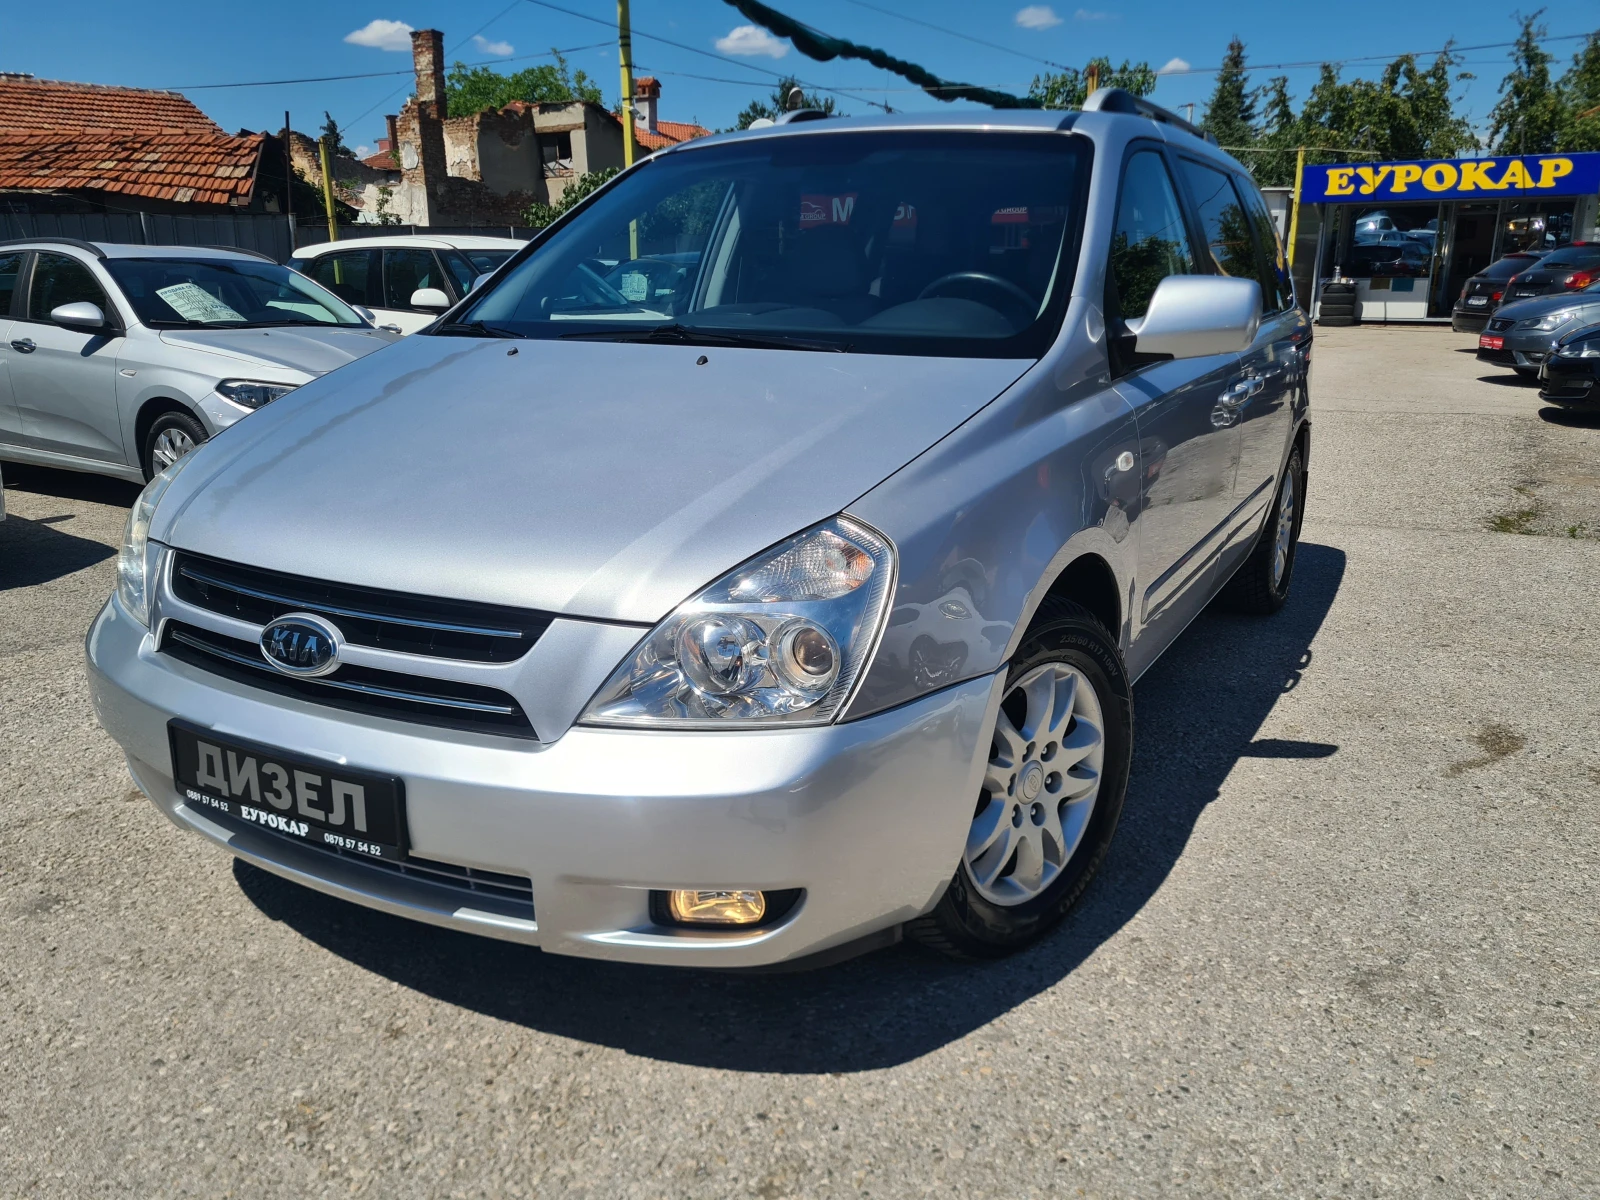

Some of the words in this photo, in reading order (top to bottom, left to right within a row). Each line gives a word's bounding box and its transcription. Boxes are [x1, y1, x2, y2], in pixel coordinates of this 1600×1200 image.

[1324, 158, 1574, 196] ЕУРОКАР
[270, 627, 320, 665] KIA
[1060, 634, 1088, 646] 235/60
[1088, 641, 1104, 655] R17
[1102, 654, 1118, 676] 106V
[196, 740, 367, 832] ДИЗЕЛ
[202, 795, 210, 804] 57
[211, 798, 219, 809] 54
[220, 801, 229, 812] 52
[240, 805, 309, 837] ЕУРОКАР
[324, 832, 344, 846] 0878
[345, 838, 356, 849] 57
[357, 842, 369, 853] 54
[370, 844, 381, 856] 52
